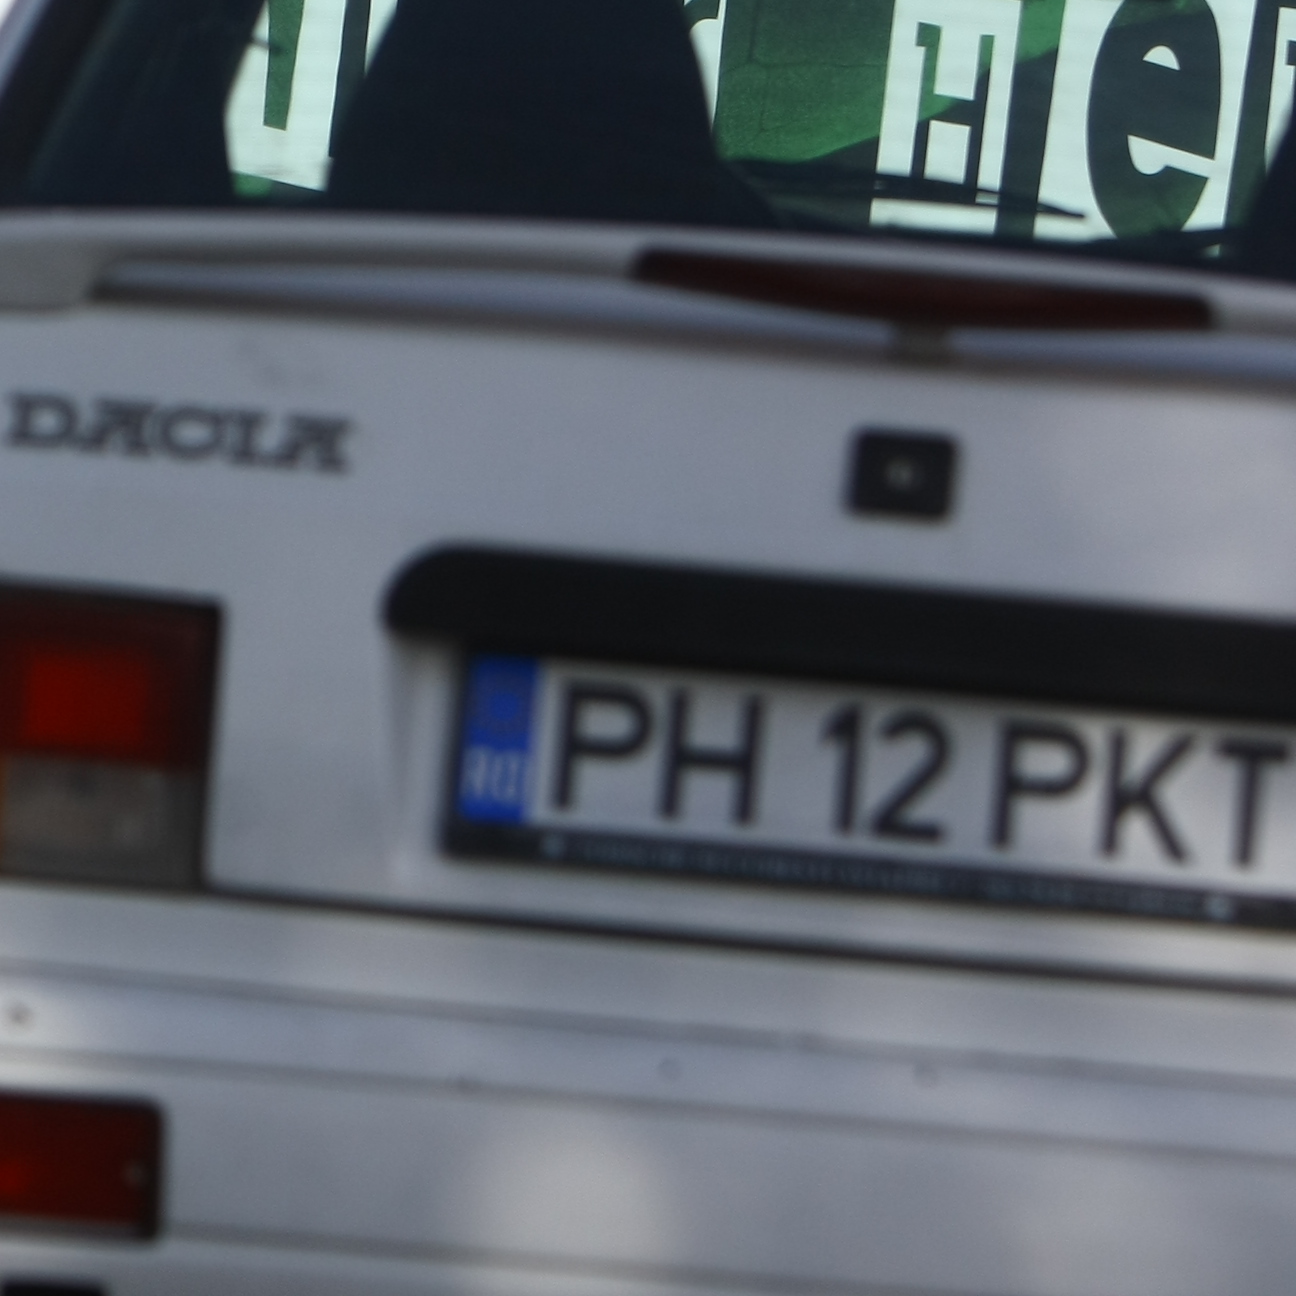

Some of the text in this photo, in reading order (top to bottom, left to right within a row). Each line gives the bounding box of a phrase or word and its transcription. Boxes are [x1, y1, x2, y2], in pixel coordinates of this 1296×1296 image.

[4, 392, 354, 476] DACIA
[550, 678, 1296, 869] PH 12 PKT
